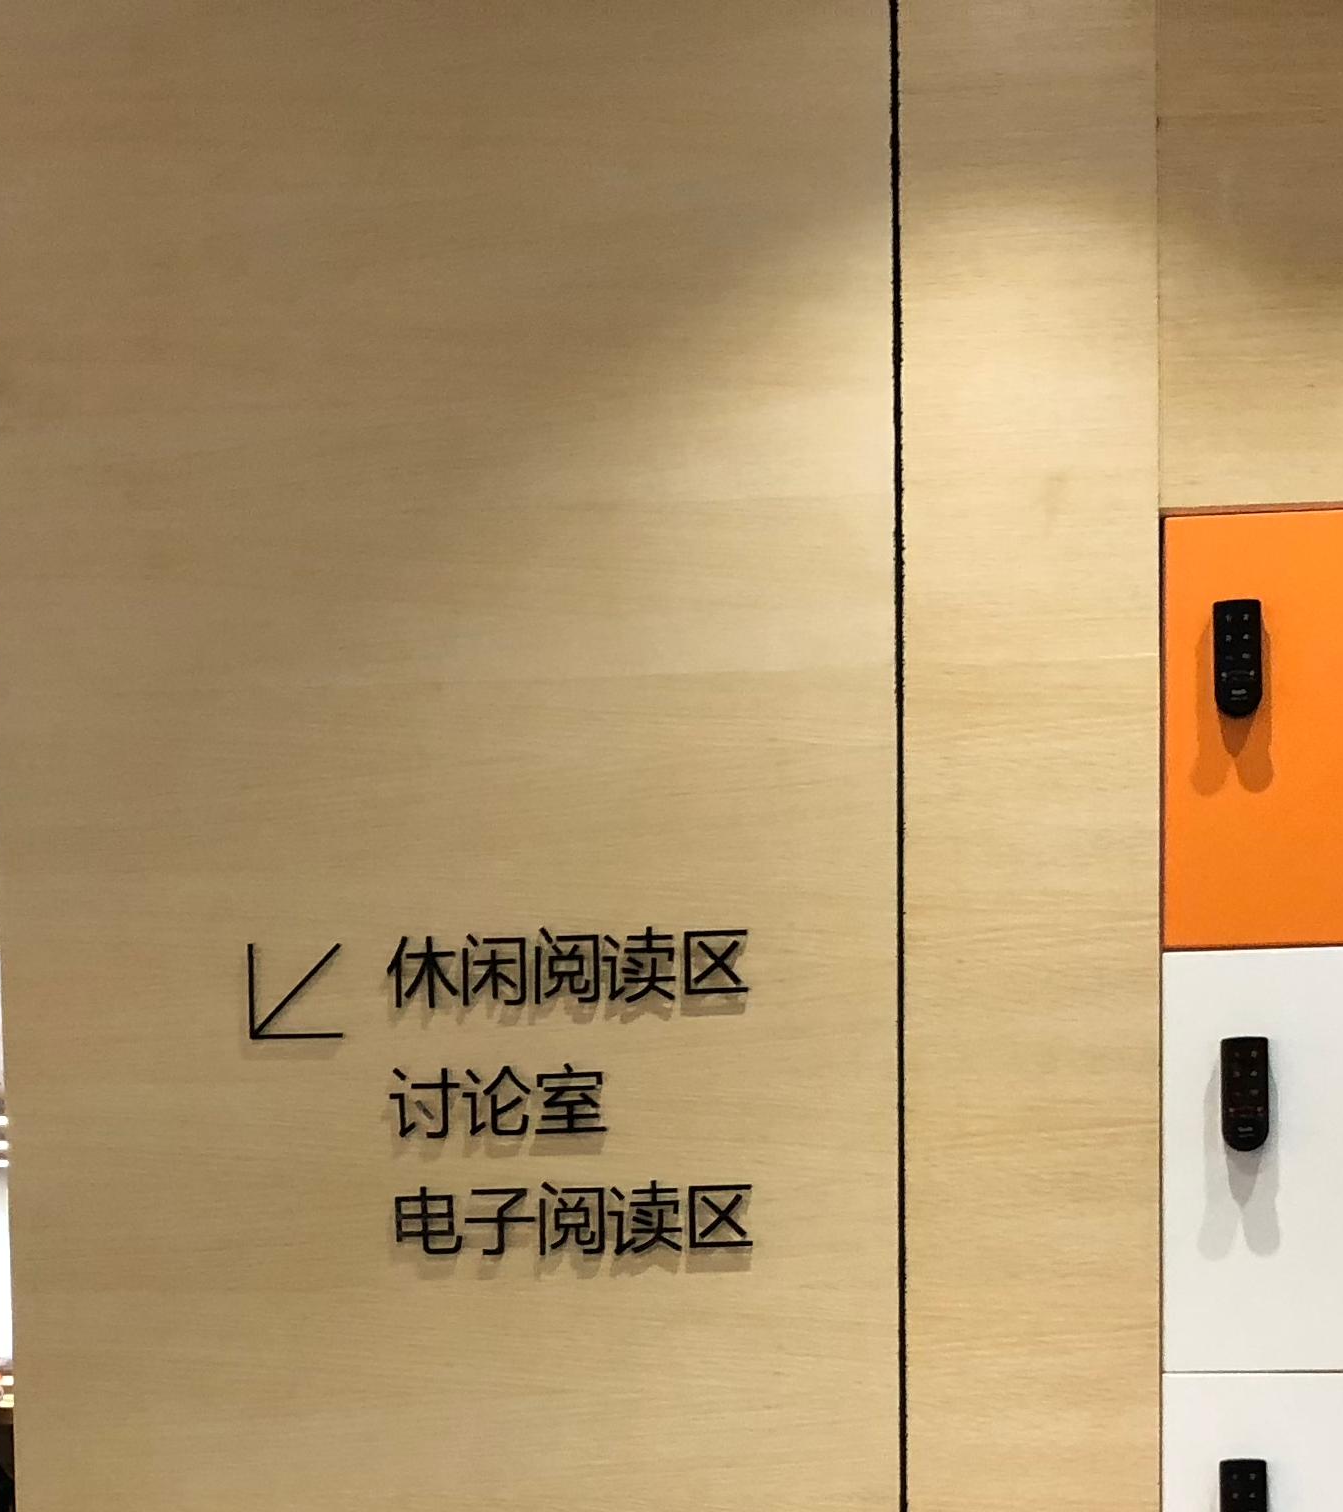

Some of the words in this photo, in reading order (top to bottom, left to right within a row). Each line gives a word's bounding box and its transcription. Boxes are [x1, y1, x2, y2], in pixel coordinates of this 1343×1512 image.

[387, 926, 749, 1008] 休闲阅读区
[389, 1063, 609, 1139] 讨论室
[394, 1179, 754, 1256] 电子阅读区
